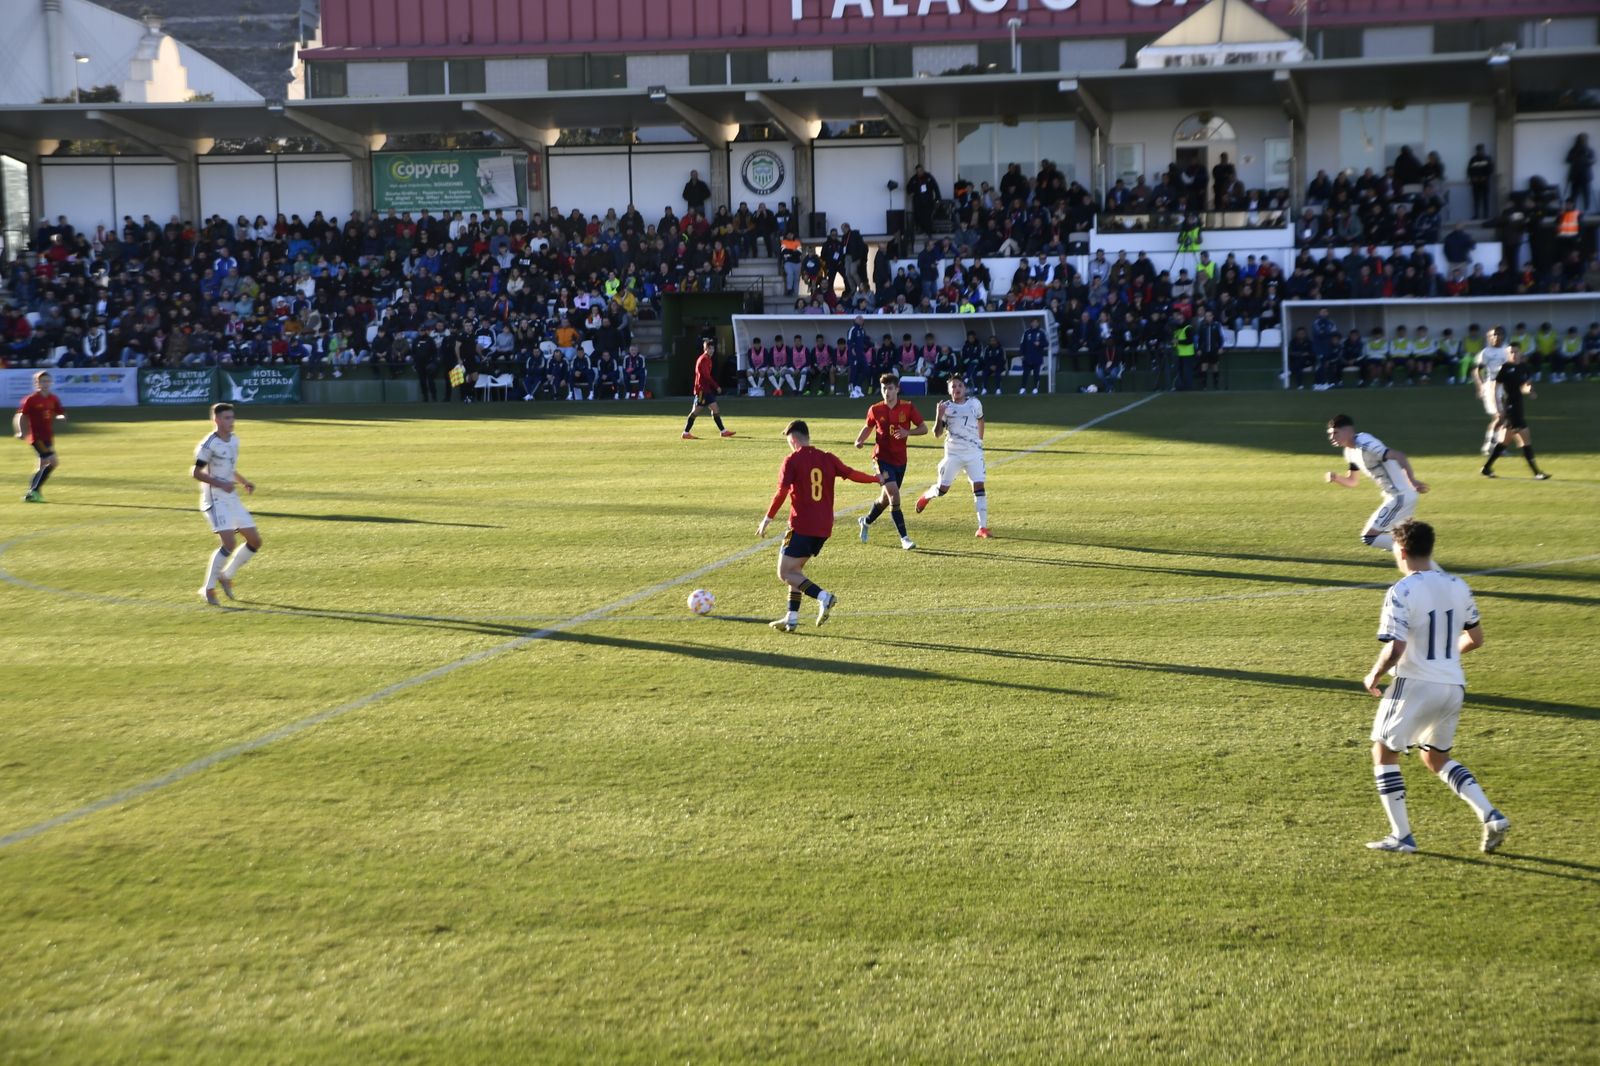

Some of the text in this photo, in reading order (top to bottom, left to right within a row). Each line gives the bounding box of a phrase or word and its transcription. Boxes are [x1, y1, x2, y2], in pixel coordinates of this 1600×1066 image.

[396, 162, 460, 179] copyrap
[251, 369, 282, 377] HOTEL
[243, 377, 294, 386] PEZ ESPADA
[962, 415, 969, 427] 7
[889, 424, 895, 436] 6
[810, 467, 823, 502] 8
[1426, 609, 1454, 660] 11
